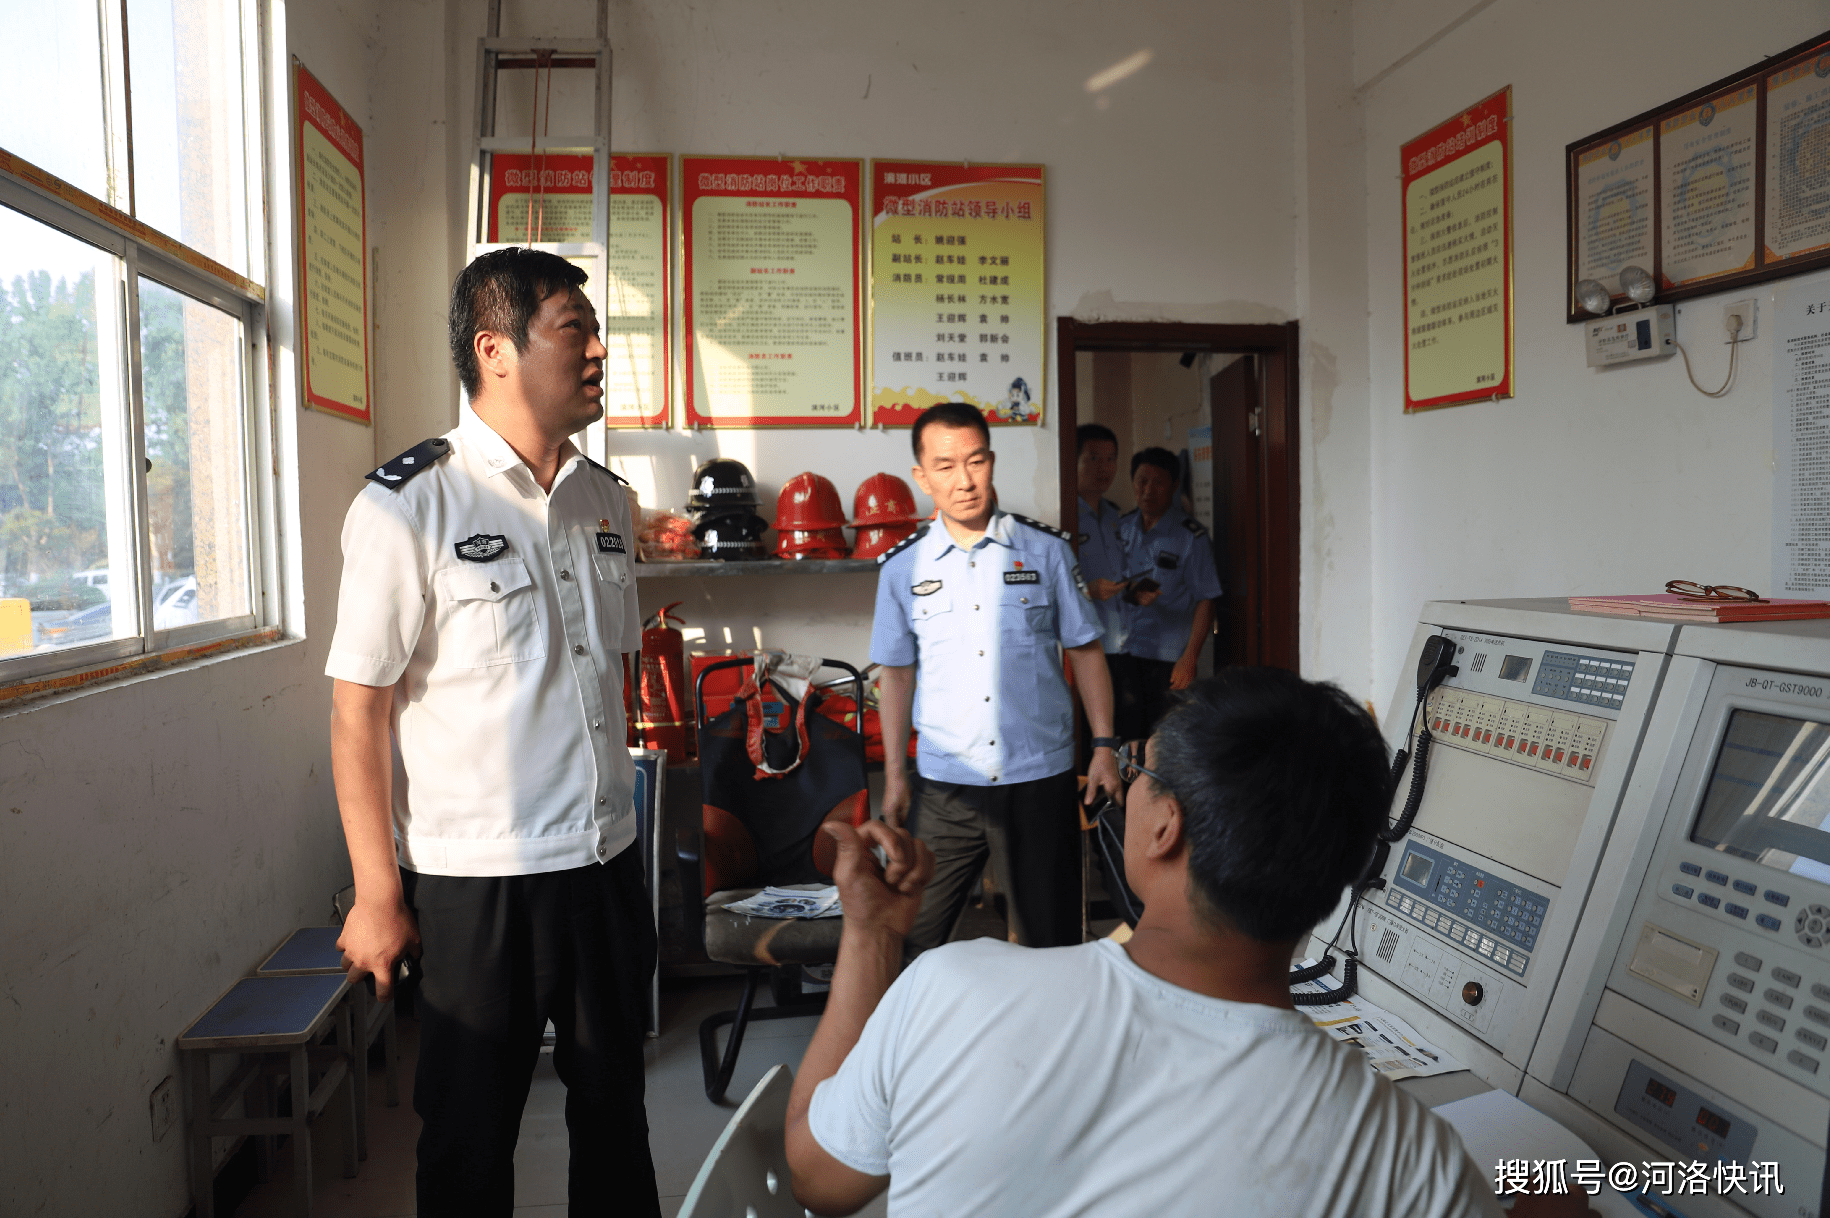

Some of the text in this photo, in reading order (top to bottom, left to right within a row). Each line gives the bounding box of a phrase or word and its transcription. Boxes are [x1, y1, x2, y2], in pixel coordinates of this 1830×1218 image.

[505, 169, 655, 189] 微型消防站理制度
[883, 196, 1032, 219] 微型消防站领导小组
[1807, 301, 1830, 316] 关于
[1745, 677, 1823, 698] JB-QT-GST9000
